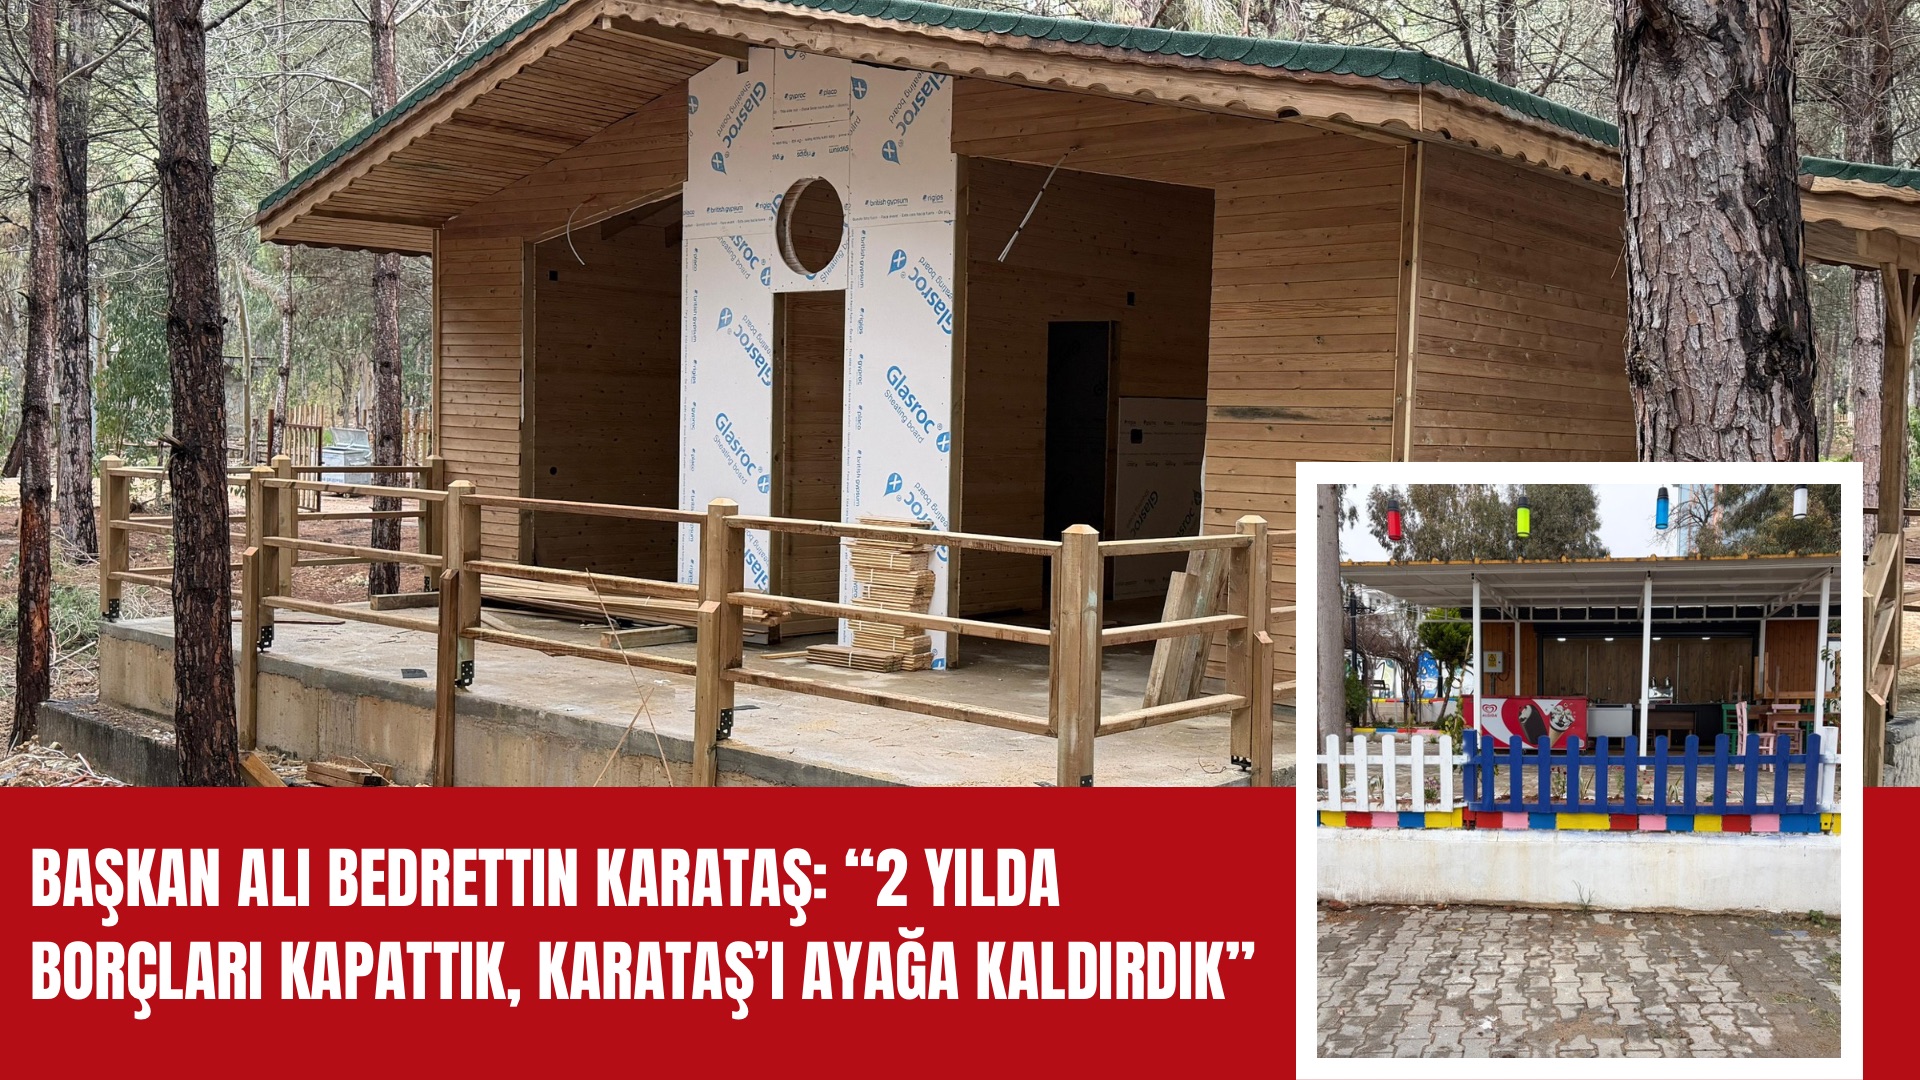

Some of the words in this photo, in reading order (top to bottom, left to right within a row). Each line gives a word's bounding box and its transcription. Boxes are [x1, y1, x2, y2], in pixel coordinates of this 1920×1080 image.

[729, 80, 751, 115] Sheating
[722, 81, 766, 148] Glasroc
[889, 98, 907, 123] board
[716, 114, 732, 138] board
[870, 199, 887, 207] british
[887, 197, 908, 207] gypsum
[928, 195, 944, 204] rigips
[734, 259, 751, 279] board
[919, 256, 936, 280] board
[742, 315, 759, 335] board
[887, 366, 935, 434] Glasroc
[884, 389, 908, 424] Sheating
[906, 419, 925, 444] board
[715, 412, 756, 476] Glasroc
[713, 434, 735, 466] Sheating
[732, 462, 748, 485] board
[915, 482, 933, 506] board
